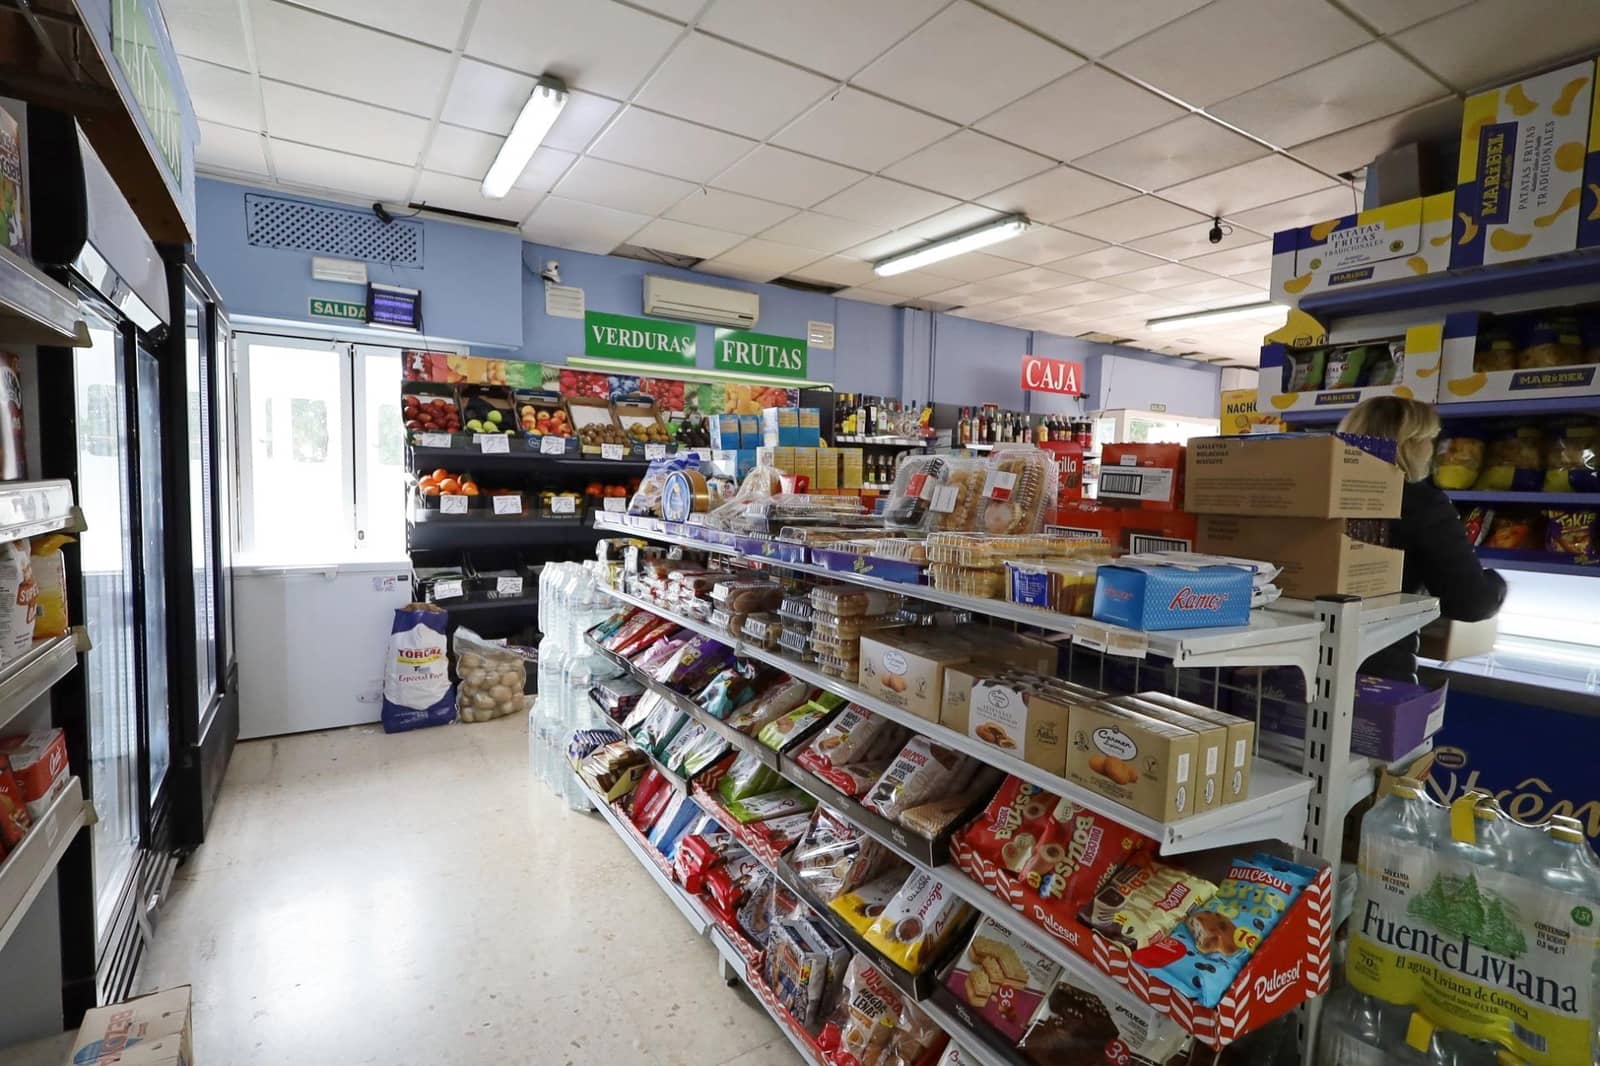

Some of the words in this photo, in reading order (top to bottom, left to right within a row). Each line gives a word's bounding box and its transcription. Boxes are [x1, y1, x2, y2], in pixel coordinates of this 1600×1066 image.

[1524, 126, 1536, 162] FRITAS
[1537, 120, 1555, 207] TRADICIONALES
[1519, 166, 1531, 210] PATATAS
[1330, 224, 1381, 242] PATATAS
[314, 302, 367, 320] SALIDA
[592, 325, 692, 353] VERDURAS
[722, 340, 802, 370] FRUTAS
[1025, 359, 1078, 392] CAJA
[1098, 729, 1132, 749] Carmen
[1229, 867, 1290, 893] DULCESOL
[1033, 905, 1080, 946] Dulcesol
[1360, 899, 1579, 1014] FuenteLiviana
[1254, 961, 1302, 1001] Dulcesol
[1395, 956, 1406, 969] El
[1407, 960, 1431, 978] agua
[1433, 970, 1472, 998] Liviana
[1474, 986, 1488, 1002] de
[1490, 994, 1529, 1020] Cuenca
